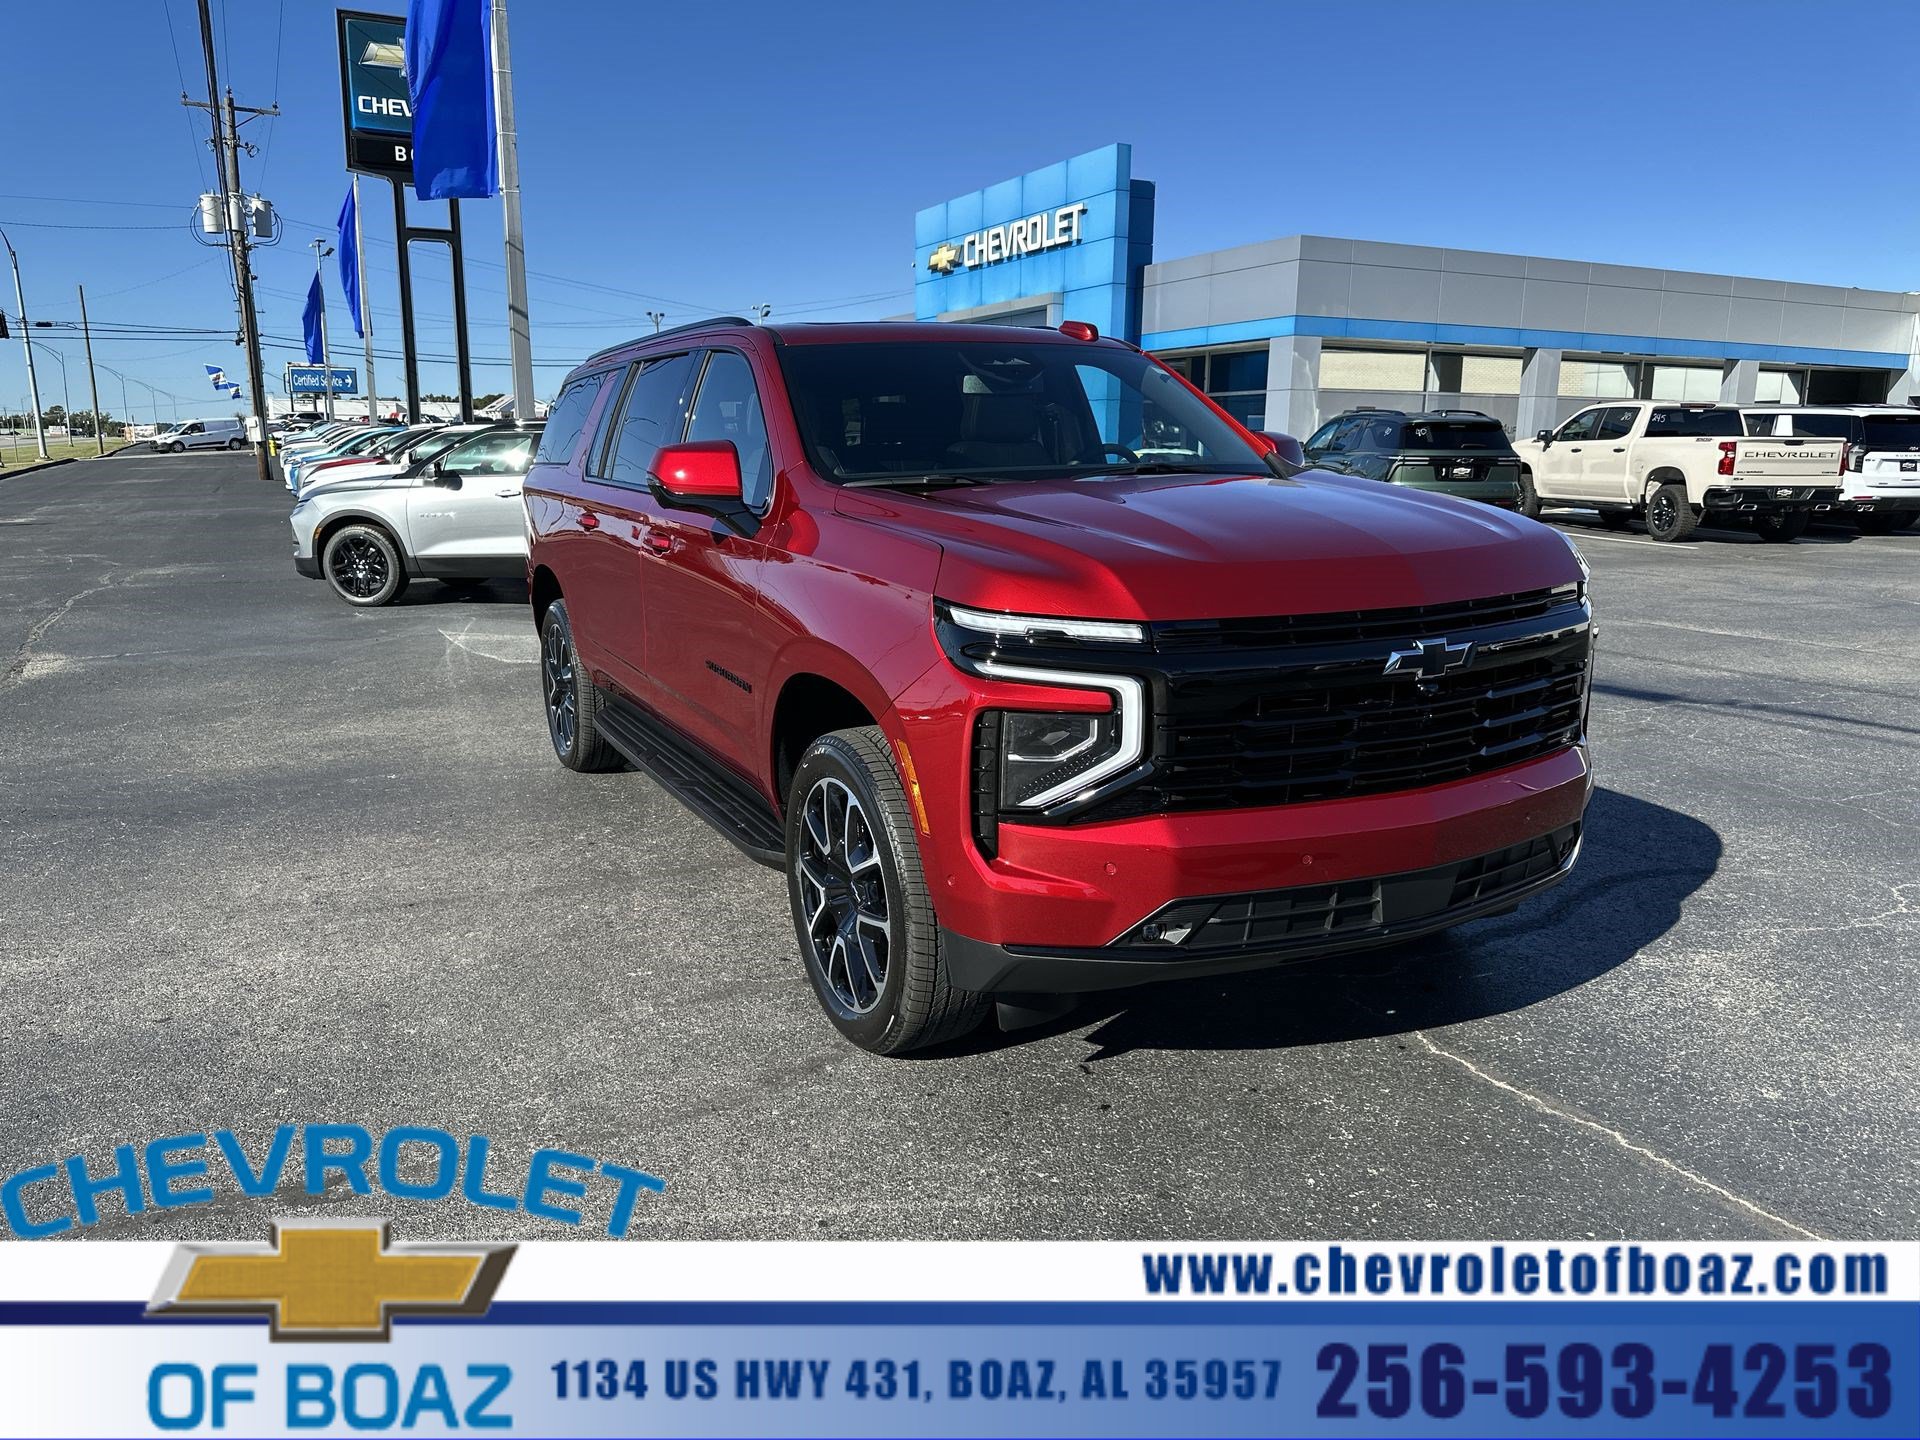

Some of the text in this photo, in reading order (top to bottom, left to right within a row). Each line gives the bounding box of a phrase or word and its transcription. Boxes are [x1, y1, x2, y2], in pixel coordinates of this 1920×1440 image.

[963, 202, 1085, 267] CHEVROLET
[293, 374, 343, 387] Certified Sevice
[1744, 451, 1837, 459] CHEVROLET
